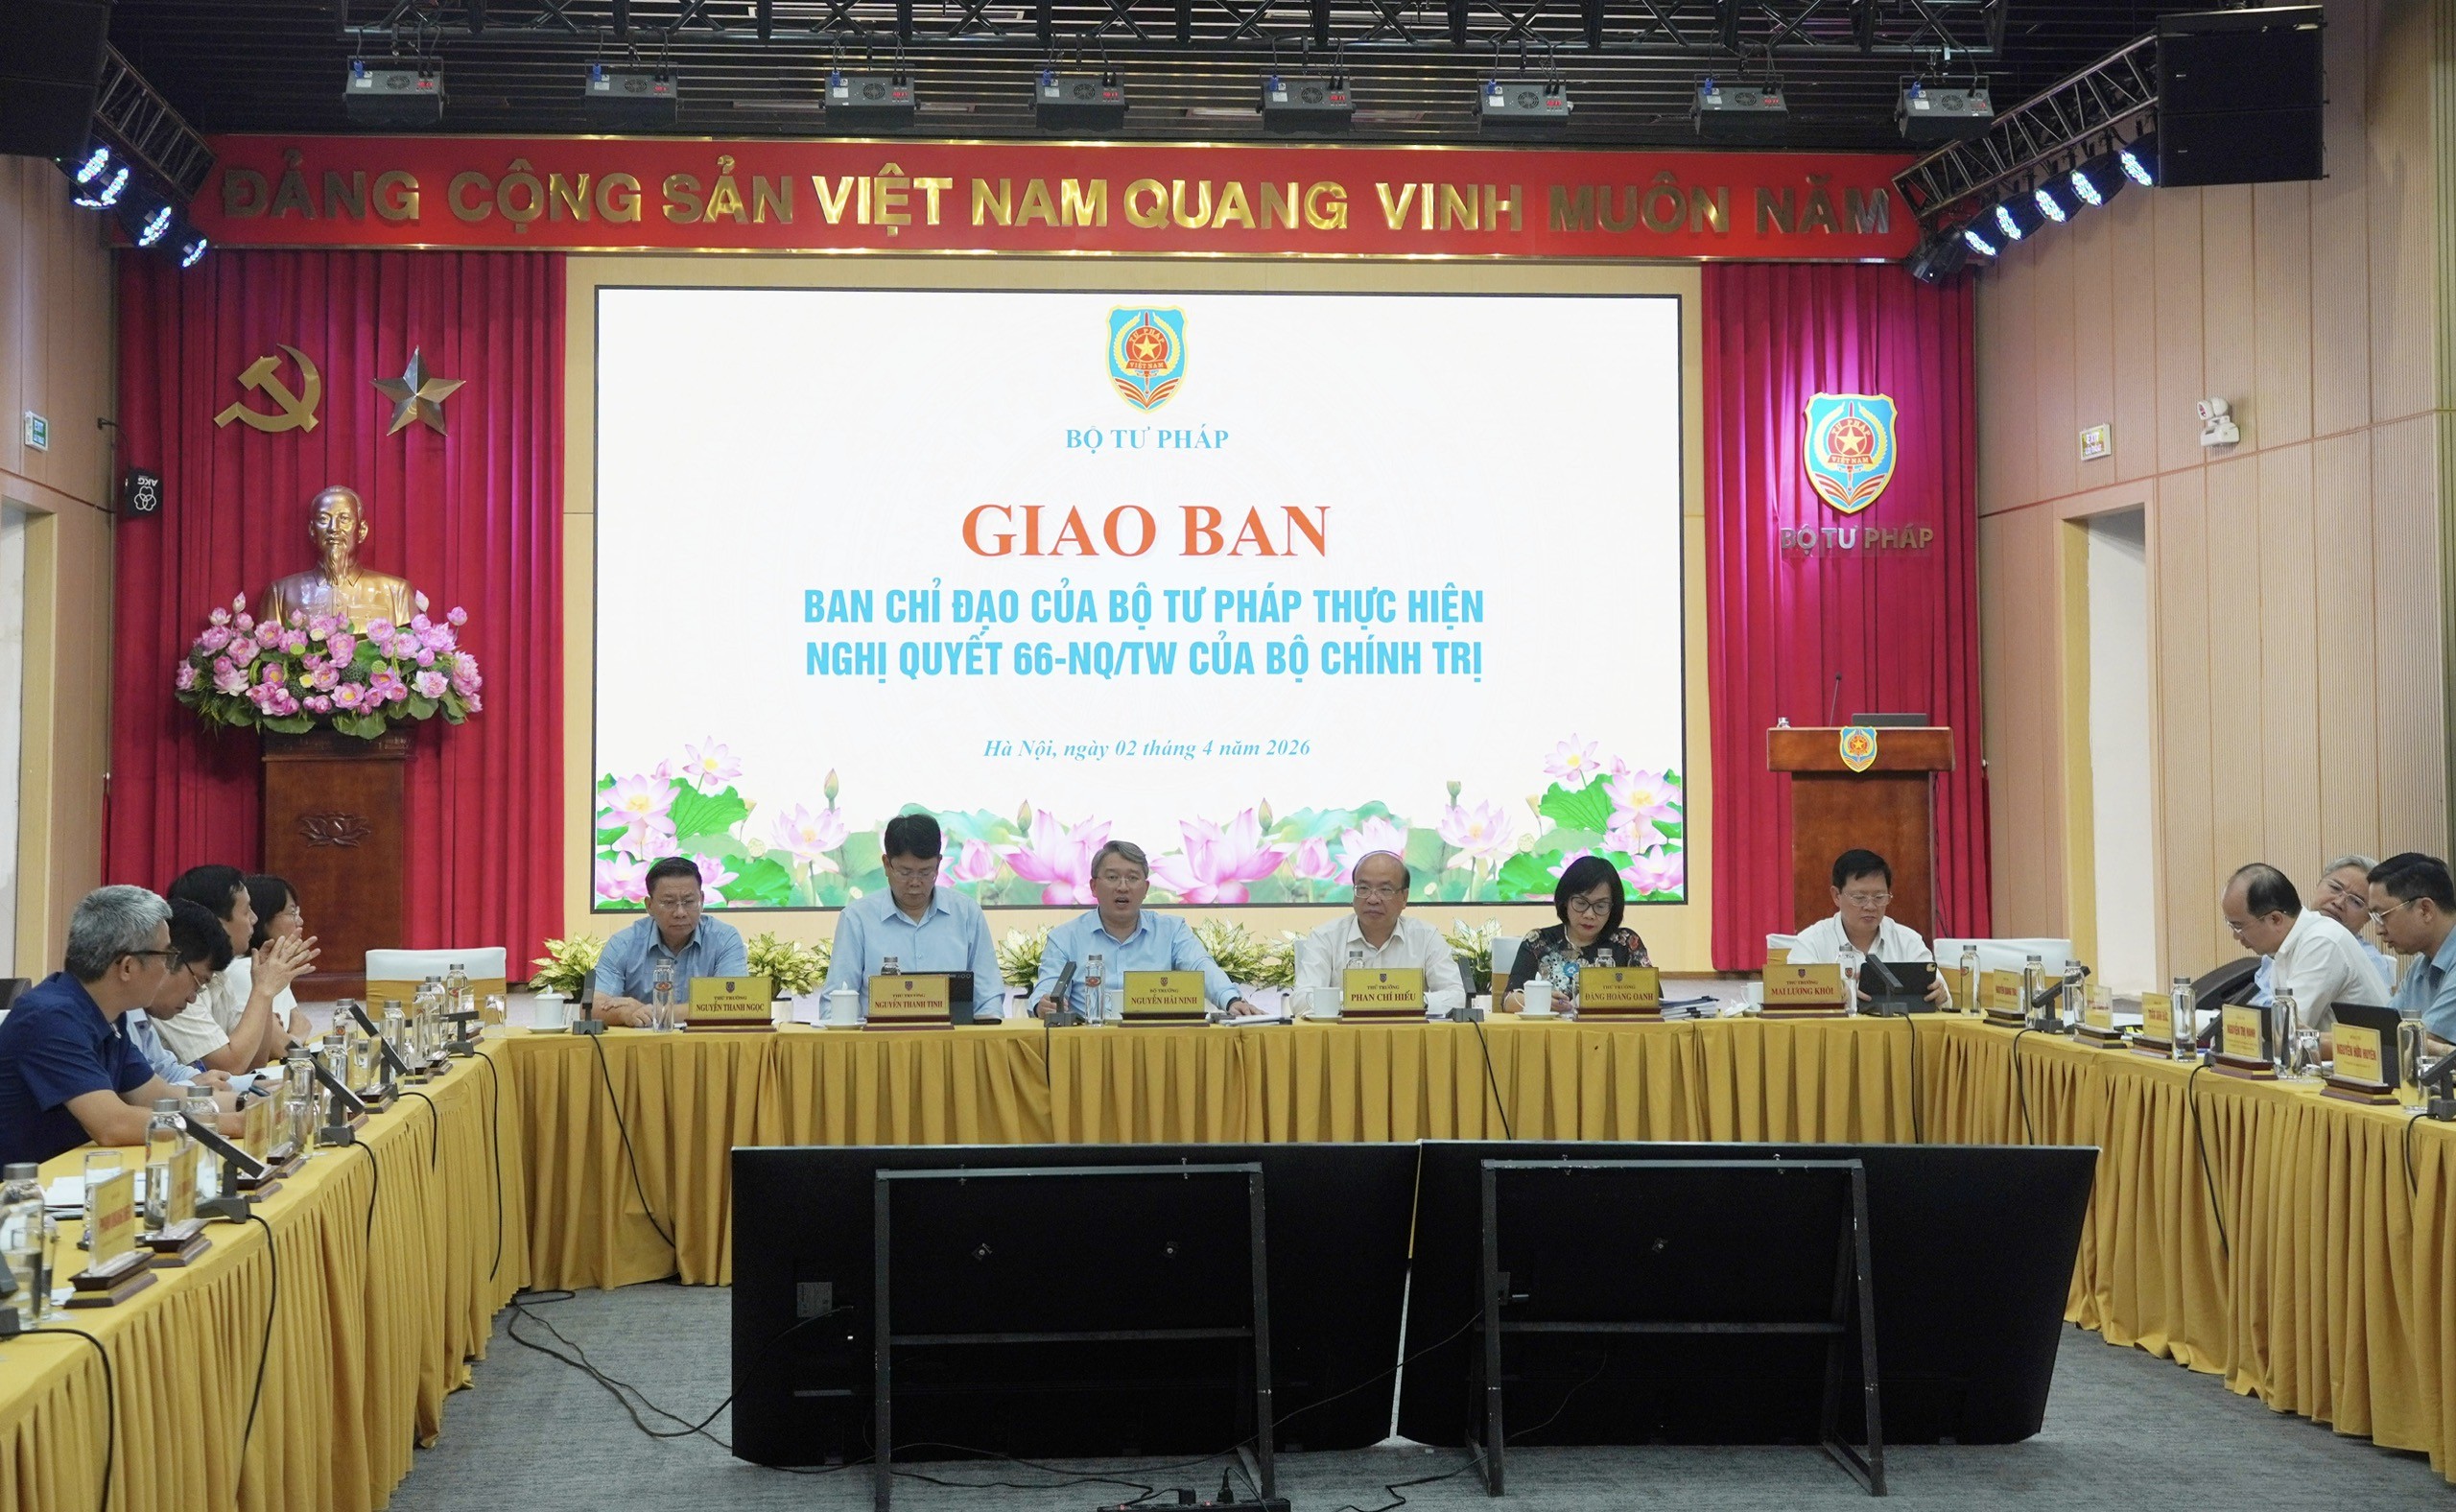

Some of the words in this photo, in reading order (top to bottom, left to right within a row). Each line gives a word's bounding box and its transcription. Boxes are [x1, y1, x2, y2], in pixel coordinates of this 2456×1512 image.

[224, 148, 419, 222] ĐẢNG
[448, 158, 642, 234] CỘNG
[662, 154, 793, 224] SẢN
[812, 162, 953, 237] VIỆT
[971, 178, 1107, 226] NAM
[1123, 178, 1348, 229] QUANG
[1375, 182, 1523, 230] VINH
[1548, 171, 1729, 233] MUÔN
[1756, 174, 1890, 234] NĂM
[1065, 425, 1104, 455] BỘ
[1111, 427, 1150, 450] TƯ
[1157, 424, 1229, 451] PHÁP
[137, 478, 158, 486] AKG
[962, 504, 1157, 556] GIAO
[1179, 506, 1331, 556] BAN
[1780, 524, 1817, 555] BỘ
[1821, 525, 1858, 550] TƯ
[1865, 523, 1934, 549] PHÁP
[804, 588, 874, 624] BAN
[886, 577, 942, 624] CHỈ
[952, 588, 1020, 630] ĐẠO
[1031, 577, 1098, 624] CỦA
[1109, 581, 1152, 630] BỘ
[1163, 585, 1211, 624] TƯ
[1217, 581, 1303, 624] PHÁP
[1312, 586, 1398, 630] THỰC
[1408, 581, 1484, 630] HIỆN
[806, 641, 887, 684] NGHỊ
[899, 630, 1003, 681] QUYẾT
[1013, 640, 1178, 680] 66-NQ/TW
[1189, 630, 1256, 676] CỦA
[1265, 633, 1310, 684] BỘ
[1321, 633, 1422, 675] CHÍNH
[1431, 640, 1482, 683] TRỊ
[983, 739, 1013, 758] Hà
[1020, 739, 1058, 761] Nội,
[1064, 741, 1109, 761] ngày
[1115, 739, 1137, 756] 02
[1143, 739, 1196, 761] tháng
[1201, 740, 1214, 756] 4
[1219, 740, 1261, 756] năm
[1265, 739, 1311, 756] 2026
[1351, 993, 1375, 1002] PHAN
[1377, 991, 1393, 1002] CHÍ
